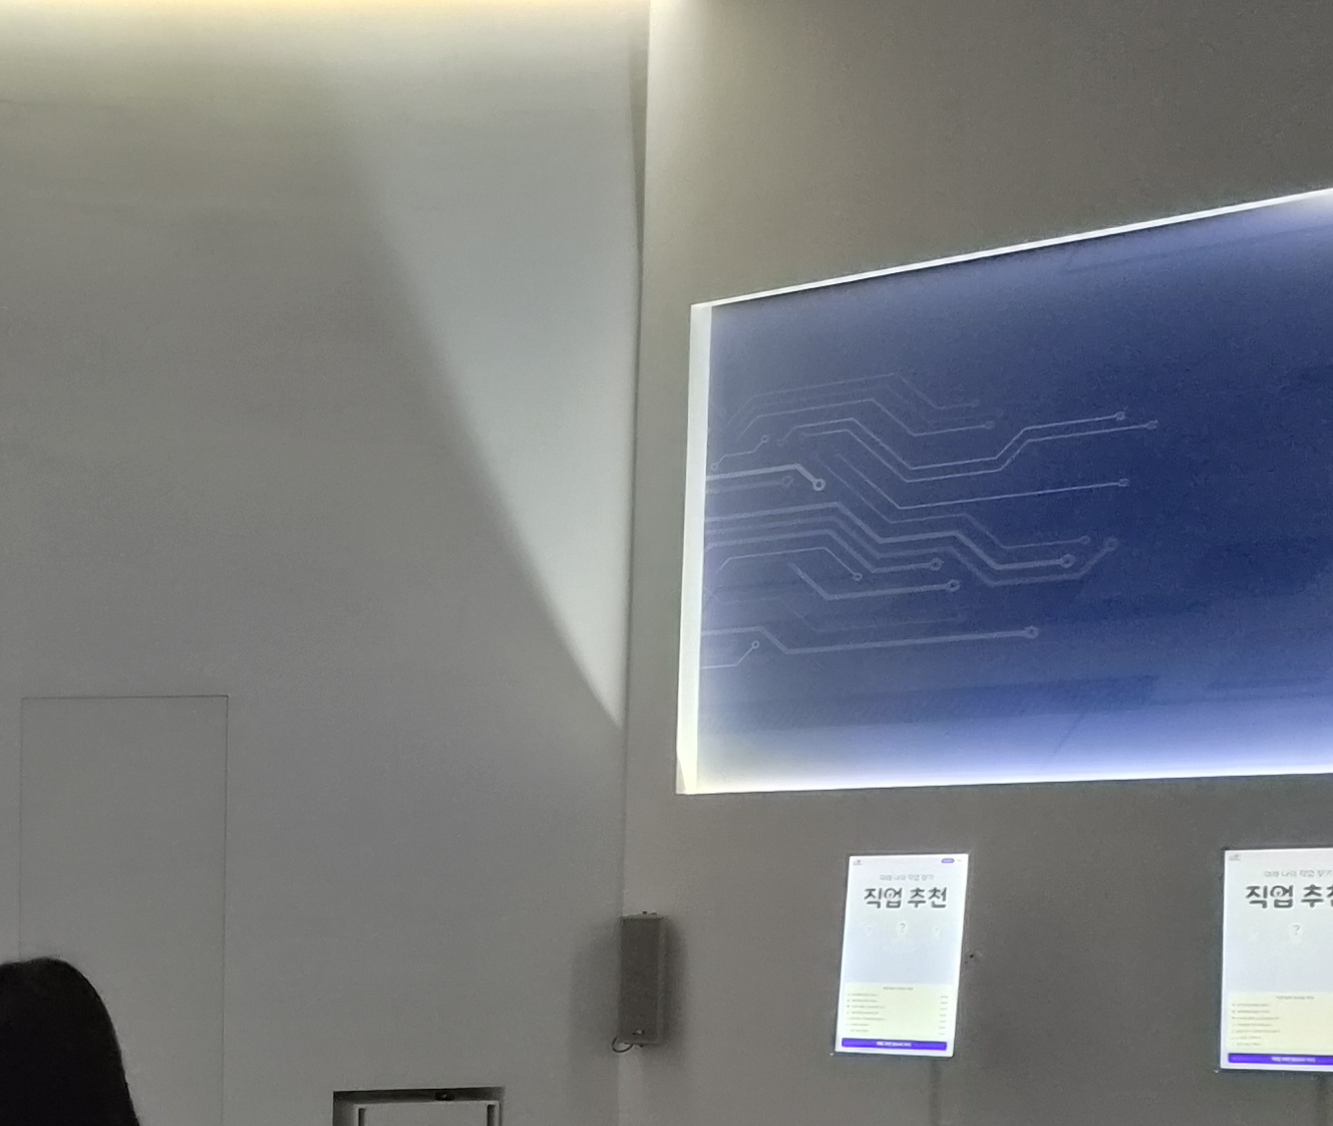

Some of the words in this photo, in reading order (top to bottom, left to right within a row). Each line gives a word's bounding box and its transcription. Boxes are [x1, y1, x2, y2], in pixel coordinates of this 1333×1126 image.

[864, 887, 903, 909] 직업
[907, 886, 948, 909] 추천
[1245, 884, 1294, 909] 직업
